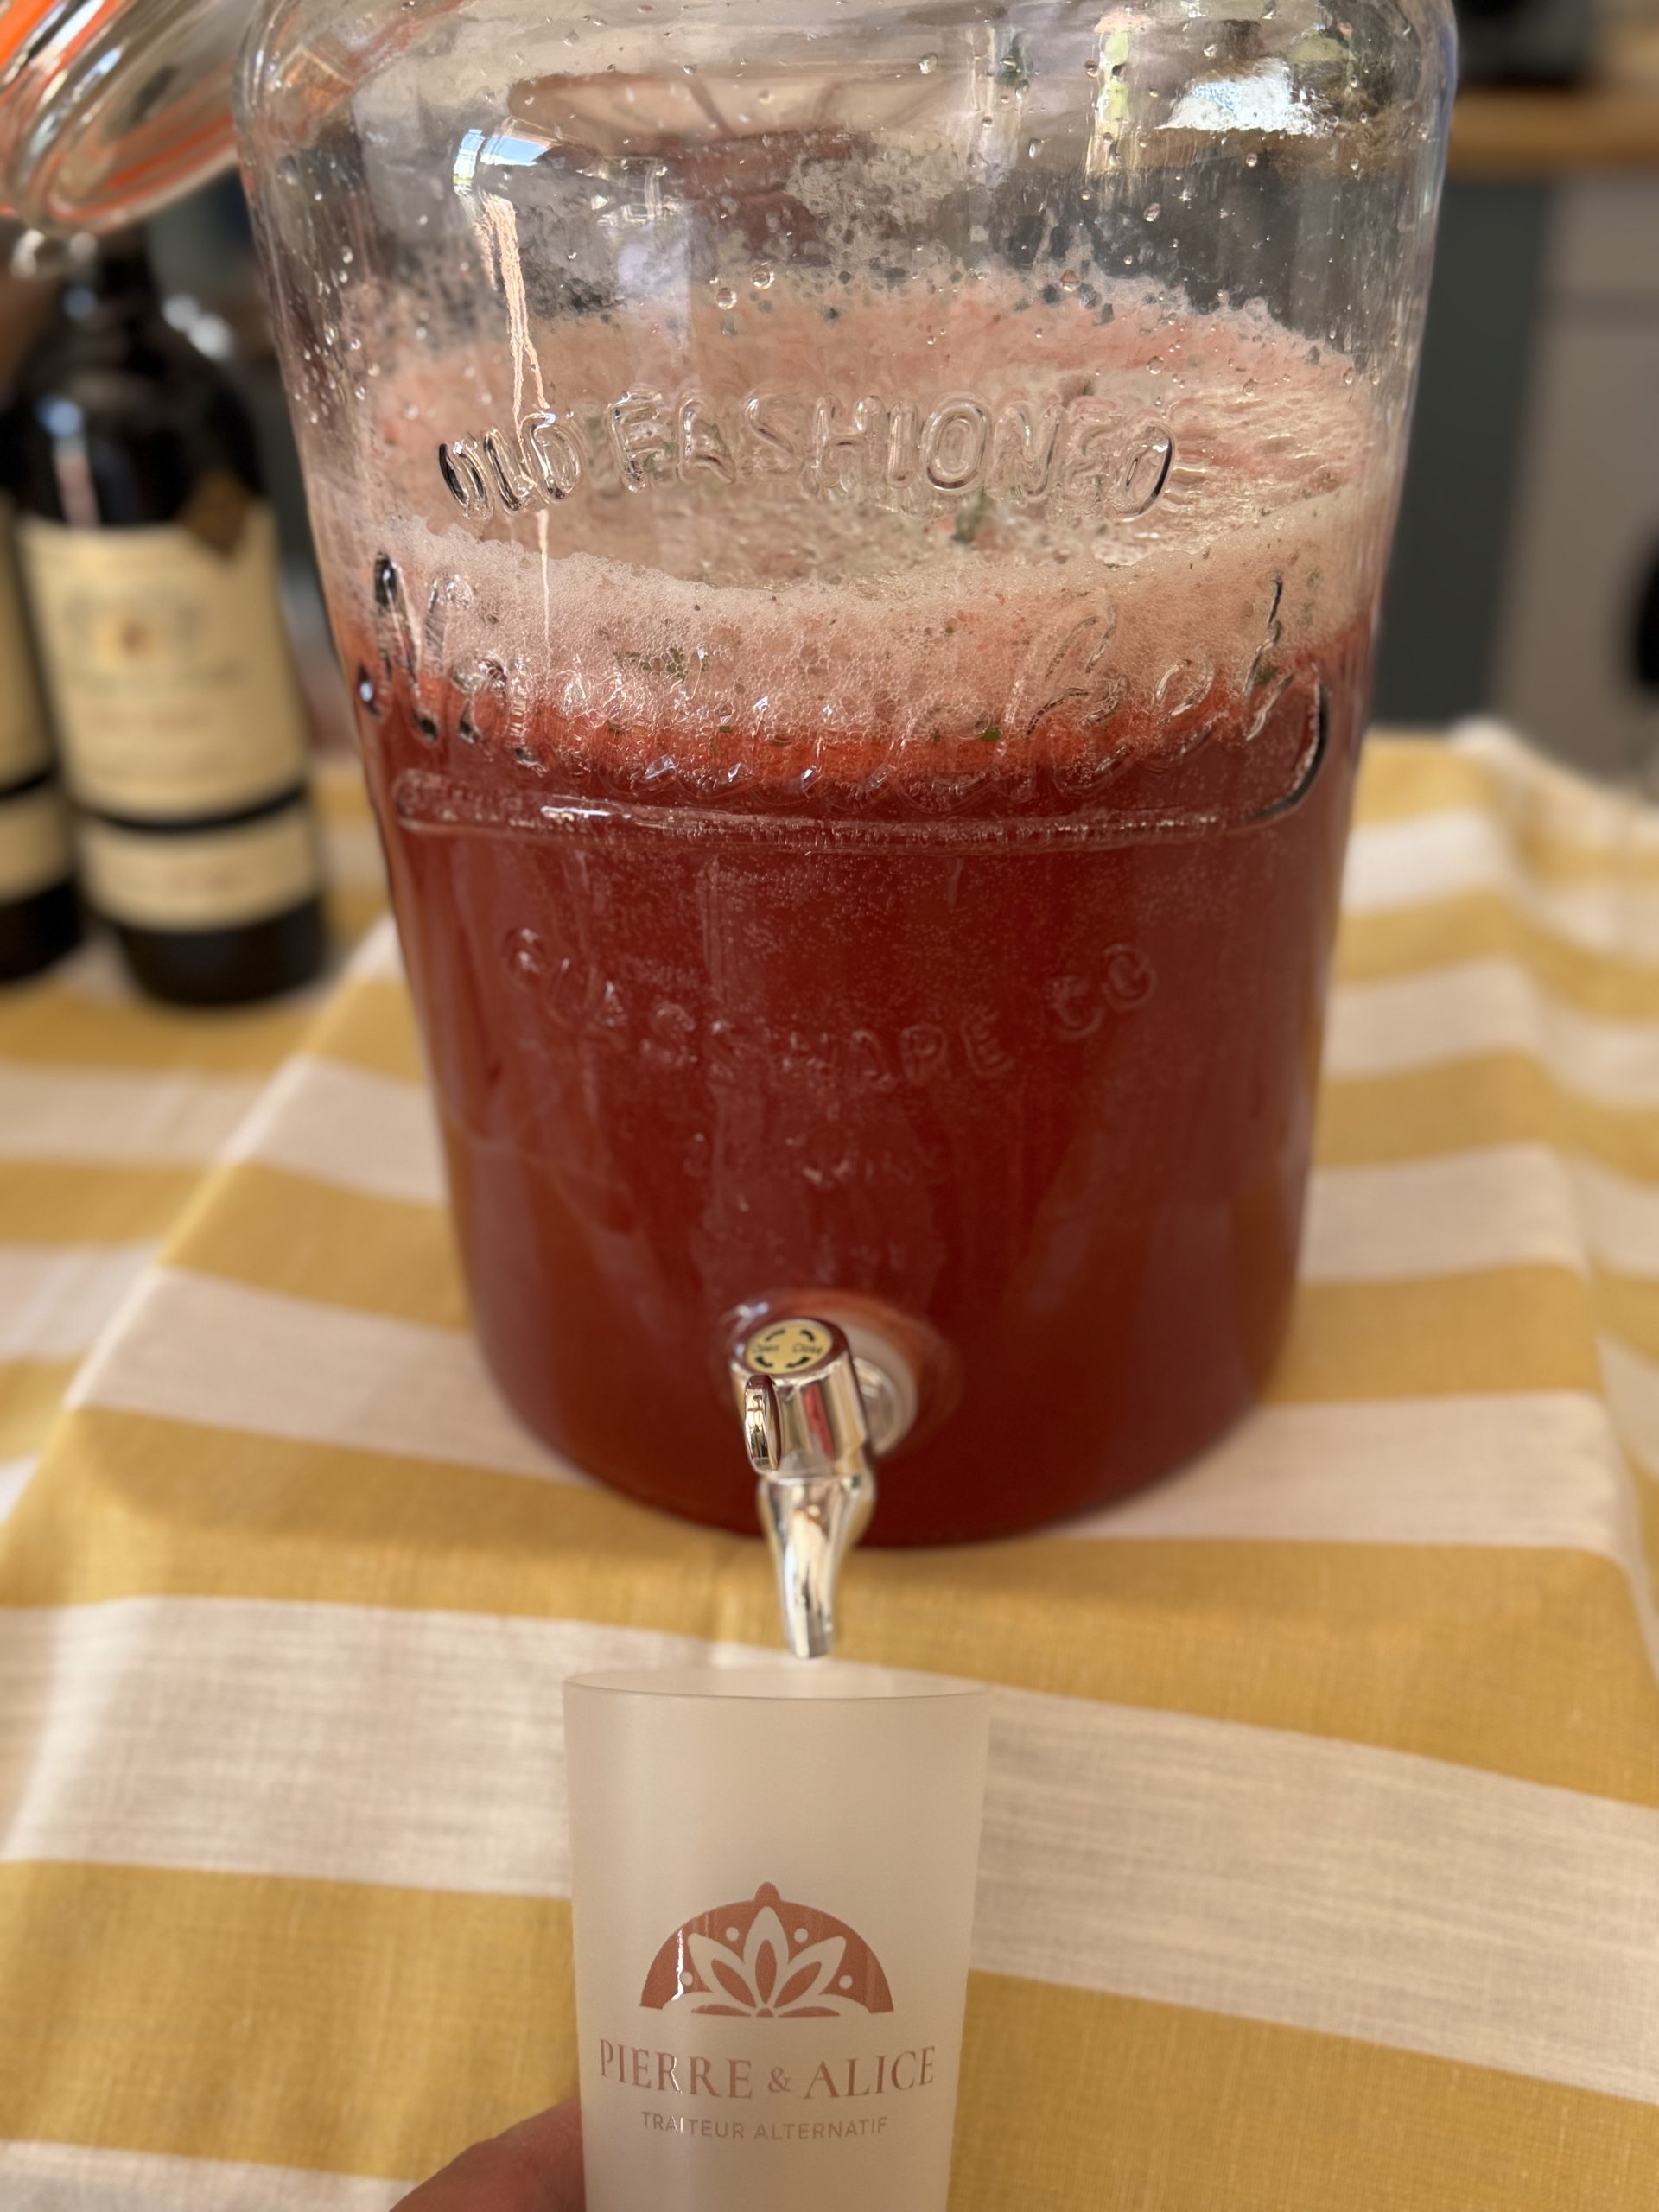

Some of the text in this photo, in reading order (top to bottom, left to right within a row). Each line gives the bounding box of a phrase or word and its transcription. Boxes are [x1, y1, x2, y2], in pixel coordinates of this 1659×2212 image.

[599, 2037, 937, 2100] PIERRE & ALICE
[640, 2110, 888, 2141] TRAITEUR ALTERNATIF
